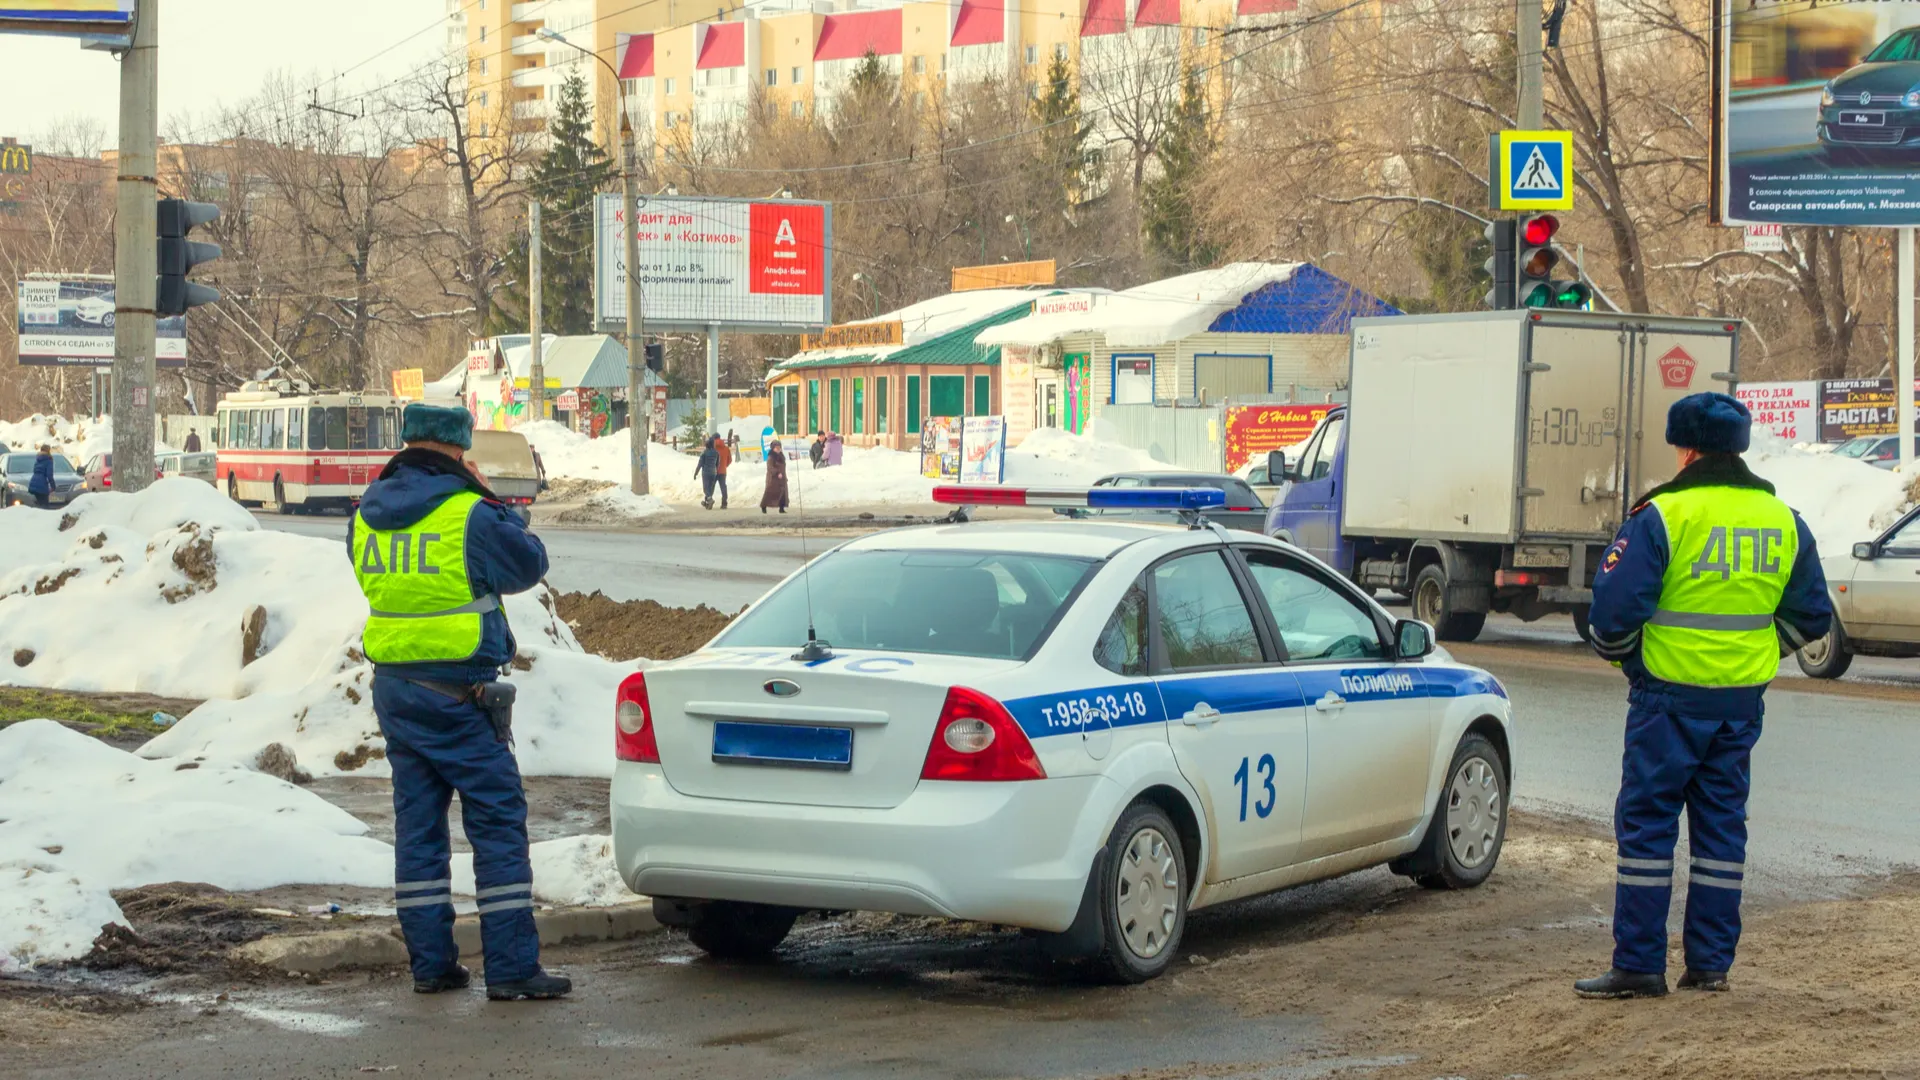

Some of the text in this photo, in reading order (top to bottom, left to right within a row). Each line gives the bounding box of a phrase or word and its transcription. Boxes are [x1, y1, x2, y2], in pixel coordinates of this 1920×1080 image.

[1749, 187, 1754, 196] В
[1783, 188, 1834, 197] официального
[1865, 186, 1905, 196] Volkswagen
[1749, 200, 1802, 212] Самарские
[1805, 200, 1866, 211] автомобили,
[668, 215, 693, 226] для
[664, 233, 672, 242] и
[676, 230, 743, 244] «Котиков»
[652, 264, 663, 272] от
[666, 264, 671, 272] 1
[675, 265, 687, 273] до
[689, 263, 704, 272] 8%
[26, 287, 57, 295] ЗИМНИЙ
[26, 294, 57, 303] ПАКЕТ
[1040, 300, 1089, 315] МАГАЗИН-СКЛАД
[68, 340, 96, 348] СЕДАН
[1826, 379, 1880, 389] 9 МАРТА 2014
[1772, 388, 1793, 399] ДЛЯ
[1757, 400, 1811, 410] РЕКЛАМЫ
[1825, 408, 1879, 424] БАСТА
[361, 532, 441, 575] ДПС
[1691, 526, 1782, 580] ДПС
[1340, 674, 1414, 696] ПОЛИЦИЯ
[1233, 752, 1277, 823] 13
